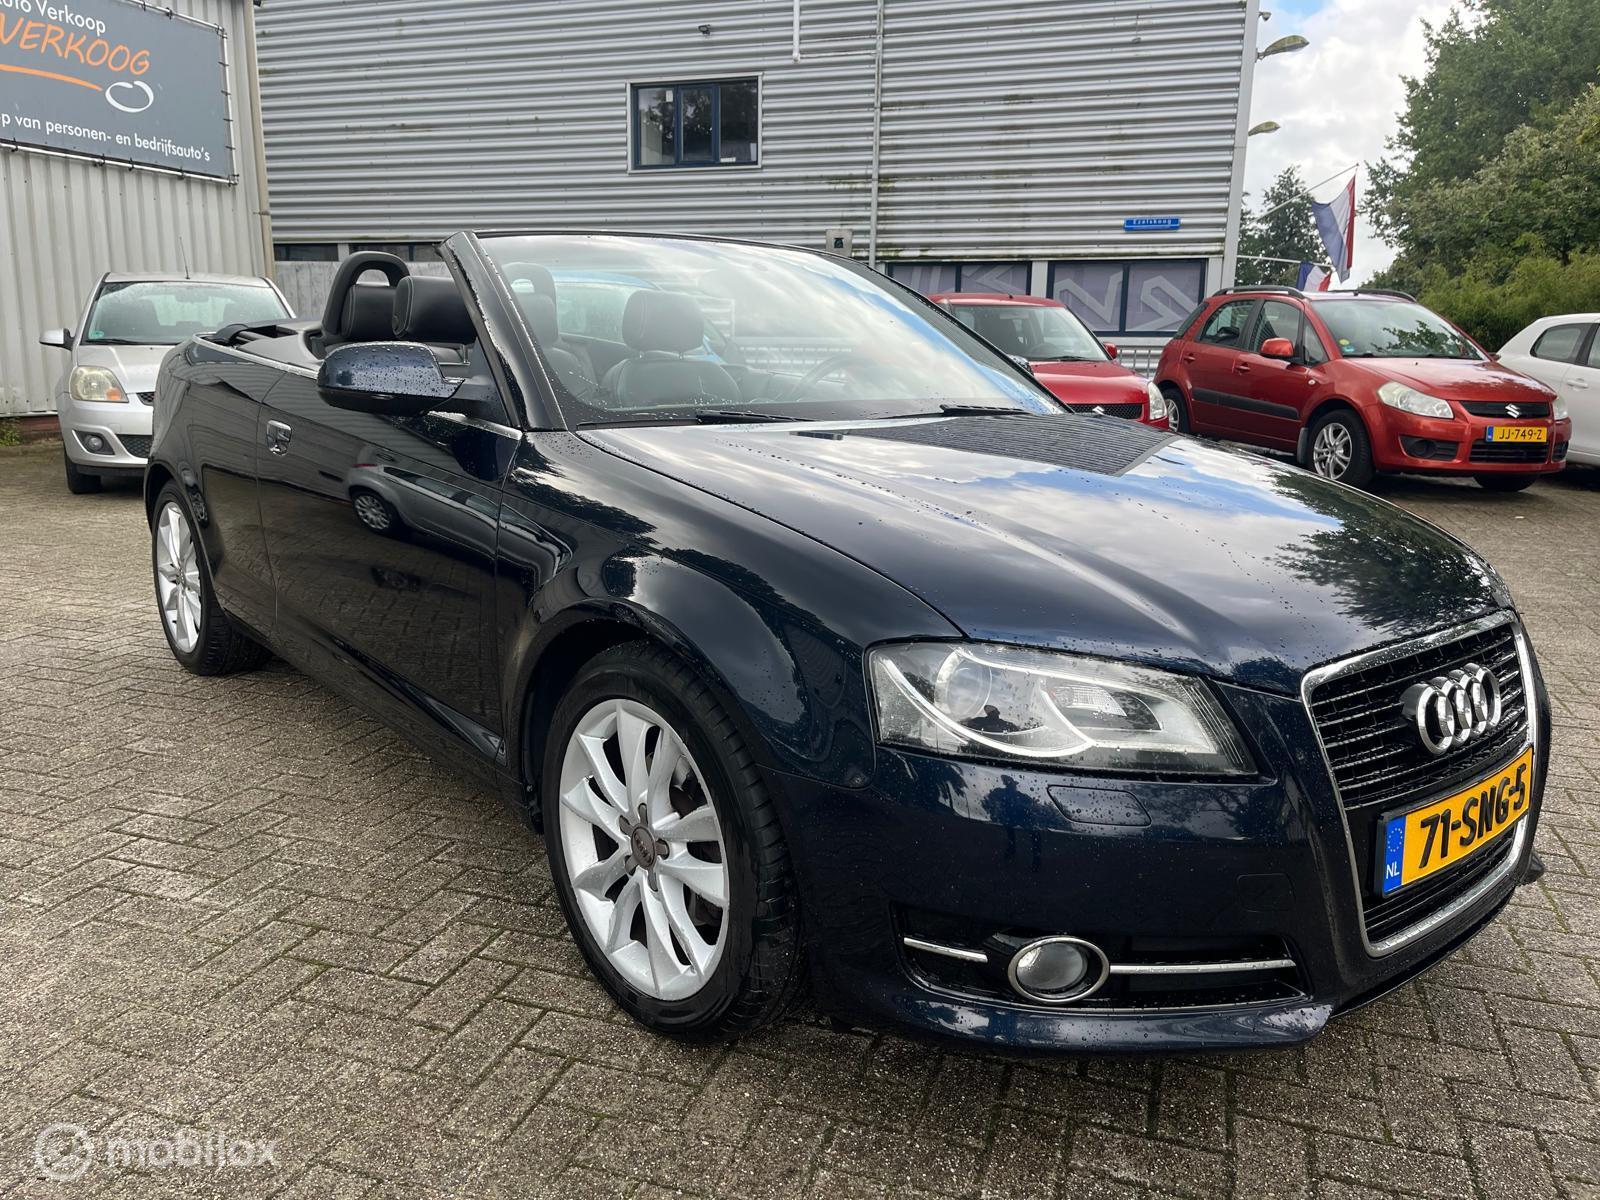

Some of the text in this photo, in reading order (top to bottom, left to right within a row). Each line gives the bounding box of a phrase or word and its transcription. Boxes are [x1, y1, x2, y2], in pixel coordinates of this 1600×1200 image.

[0, 0, 106, 37] uto Verkoop
[0, 12, 150, 75] VERKOOG
[15, 115, 41, 129] van
[46, 120, 111, 141] personen-
[115, 133, 131, 146] en
[134, 132, 210, 161] bedrijfsauto's
[1499, 429, 1542, 440] JJ-749-Z
[1419, 764, 1526, 868] 71-SNG-5
[1386, 861, 1399, 879] NL
